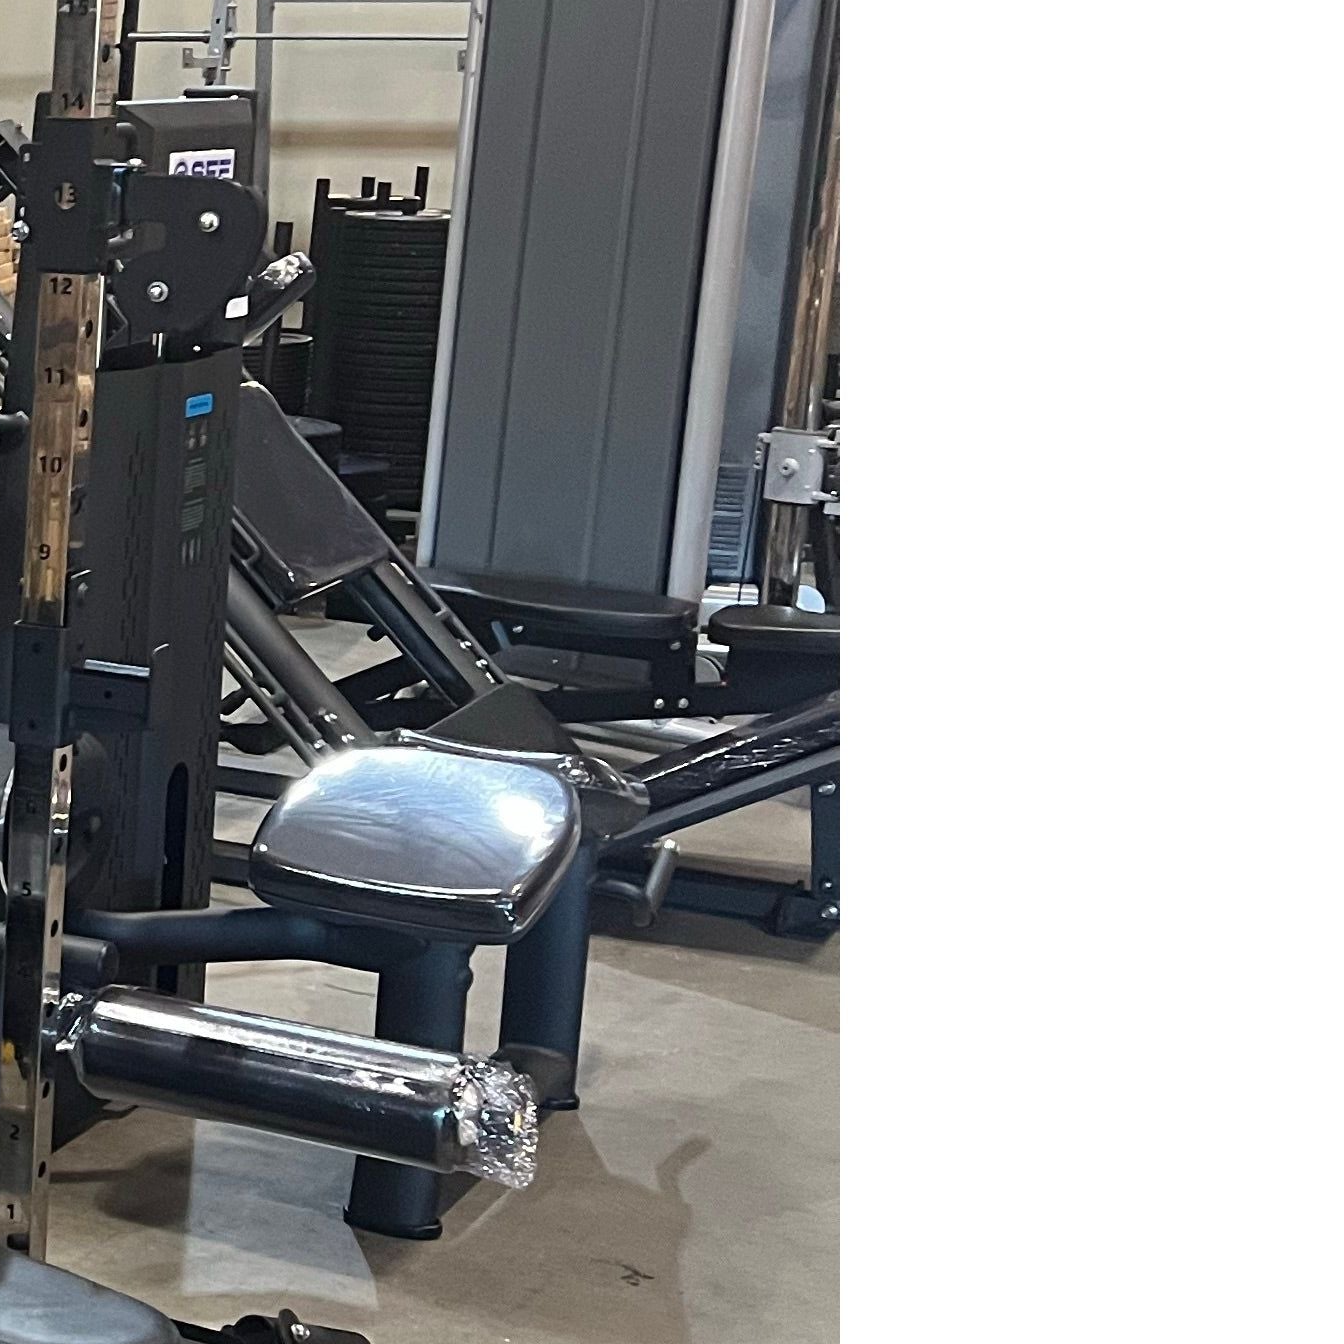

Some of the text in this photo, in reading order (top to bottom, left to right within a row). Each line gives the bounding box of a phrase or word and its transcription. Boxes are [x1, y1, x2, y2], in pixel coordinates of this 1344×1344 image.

[60, 93, 85, 112] 14
[49, 278, 73, 295] 12
[43, 367, 67, 386] 11
[39, 457, 63, 474] 10
[39, 543, 52, 561] 9
[21, 882, 32, 896] 5
[9, 1124, 20, 1141] 2
[5, 1203, 15, 1220] 1
